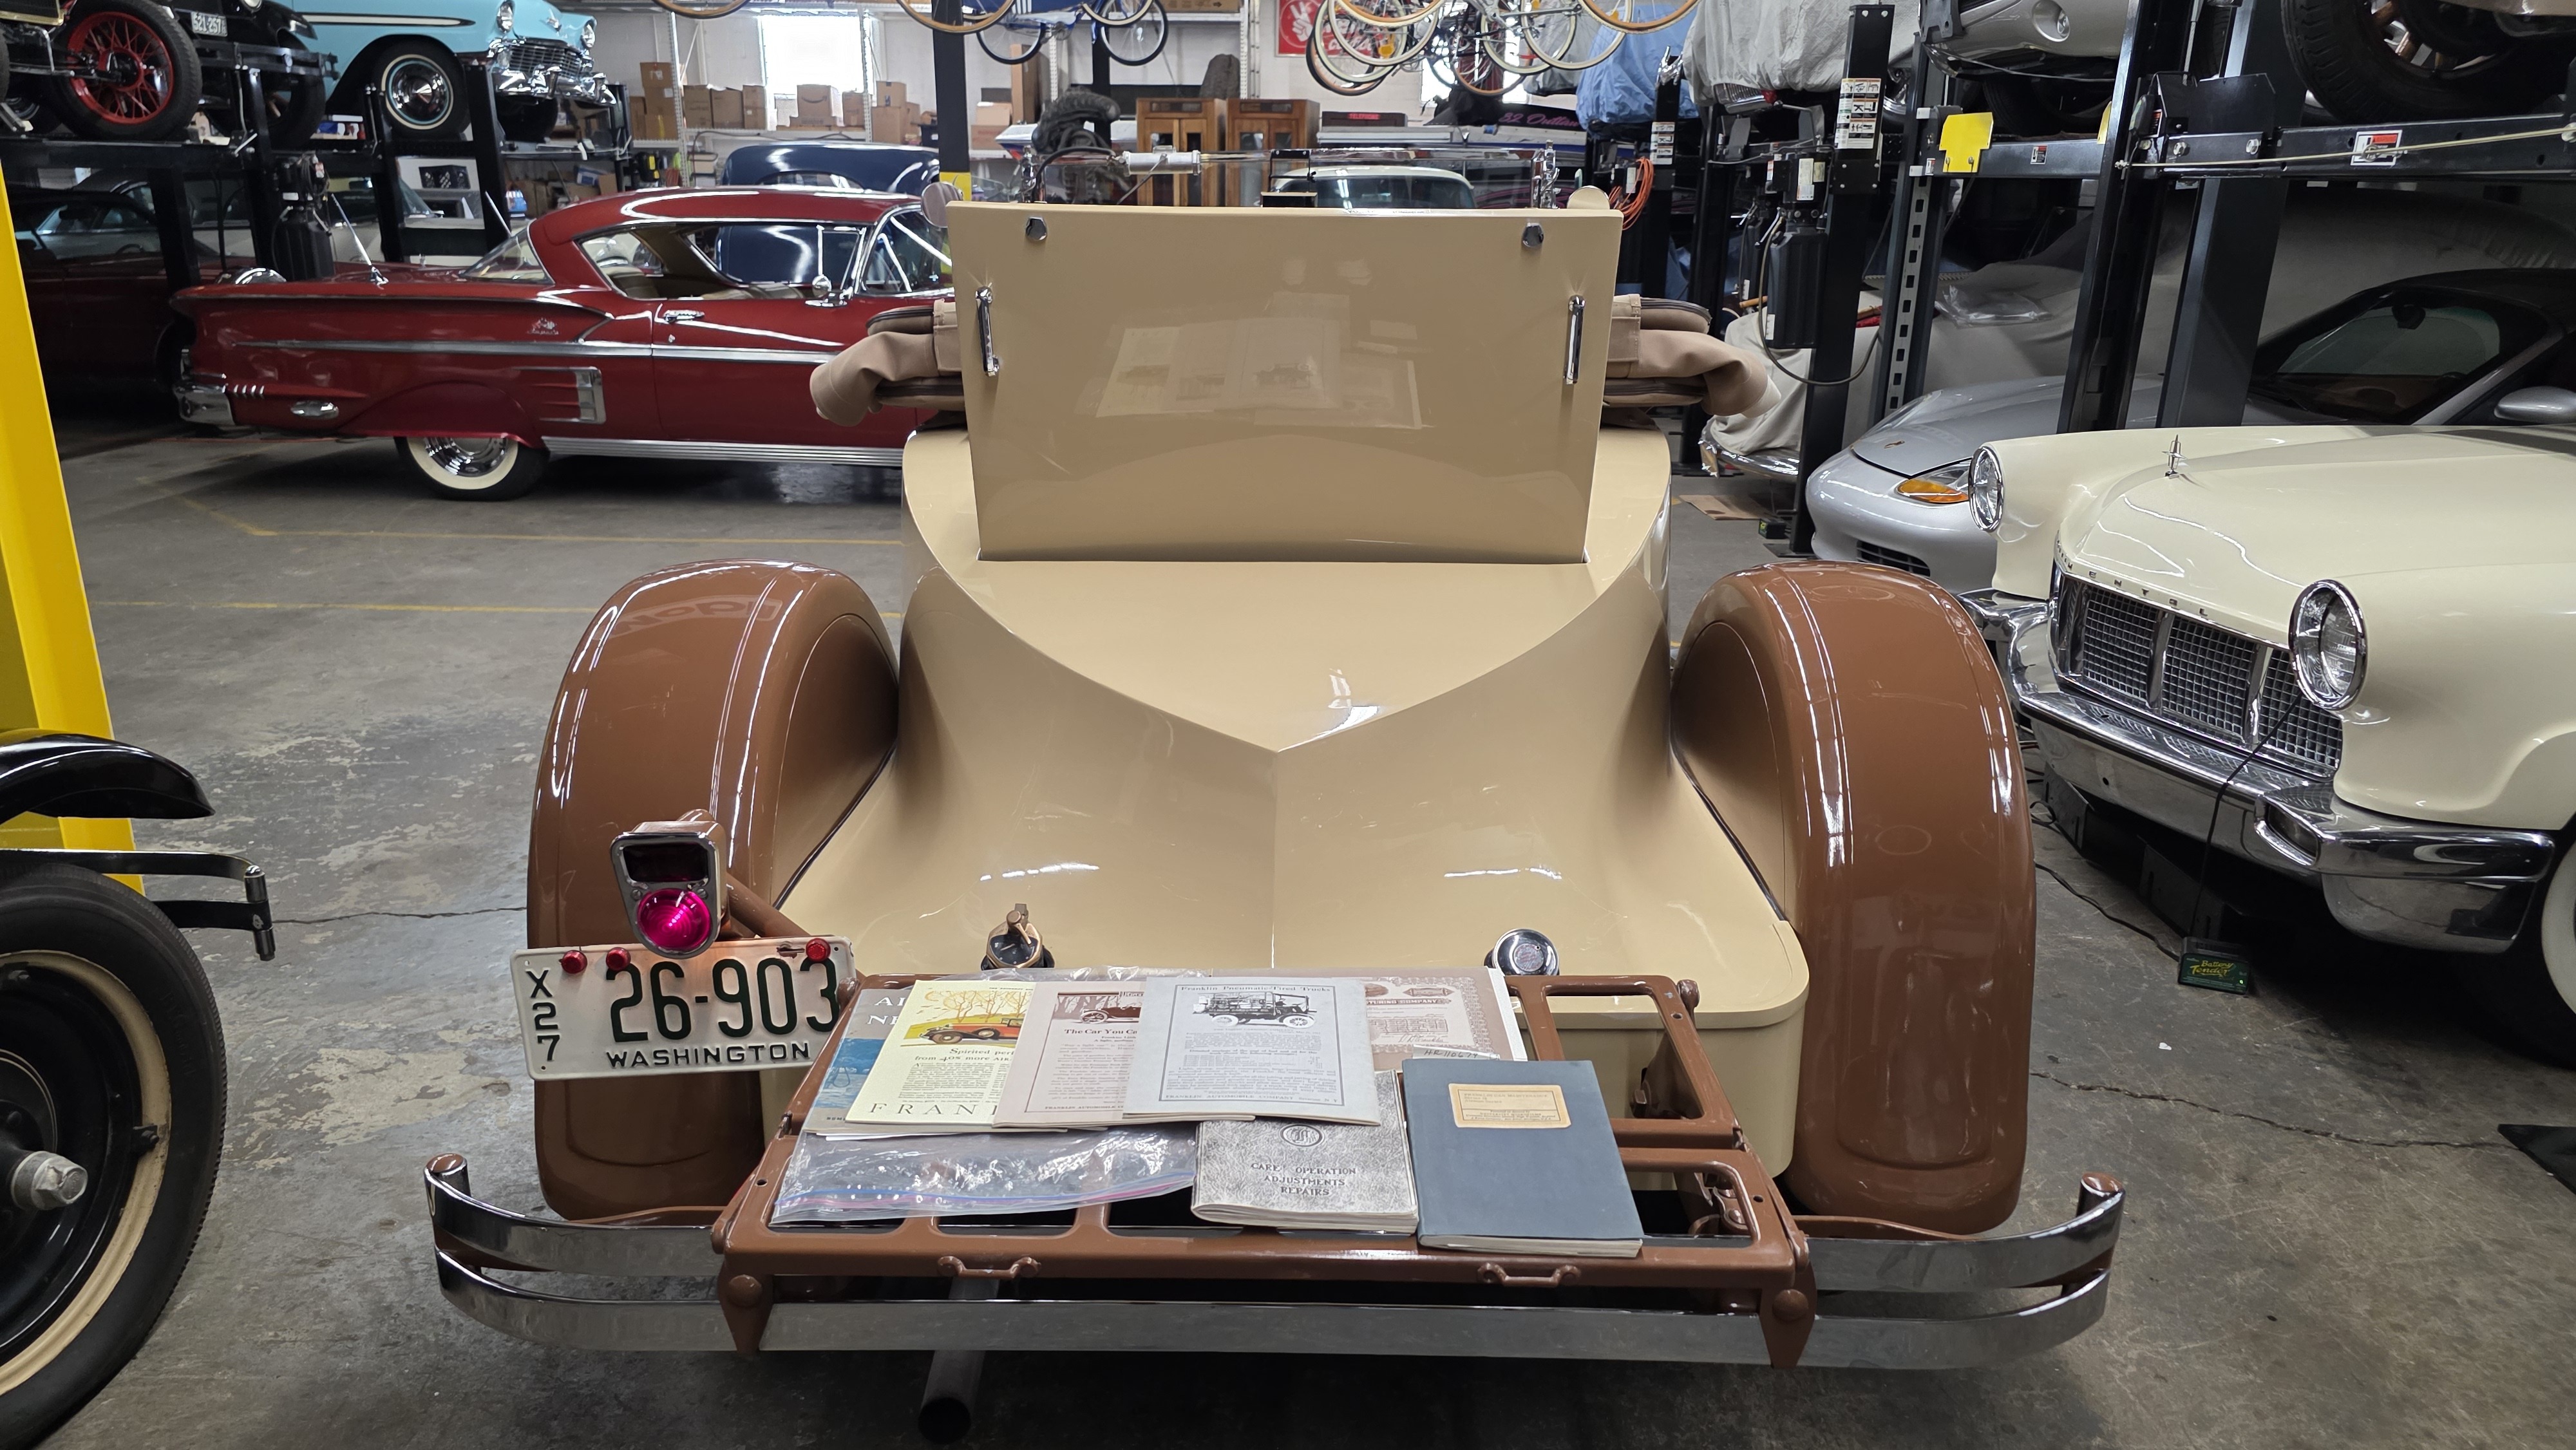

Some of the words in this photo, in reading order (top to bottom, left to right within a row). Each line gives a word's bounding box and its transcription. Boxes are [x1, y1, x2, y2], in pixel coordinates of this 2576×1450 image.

[2201, 960, 2235, 970] Battery
[2190, 965, 2230, 977] Tender
[605, 957, 840, 1043] 26-903
[606, 1041, 810, 1068] WASHINGTON
[869, 1102, 998, 1116] FRAN
[1295, 1167, 1356, 1175] OPERATION
[1264, 1176, 1345, 1186] ADJUSTMENTS
[1281, 1187, 1330, 1196] REPAIRS
